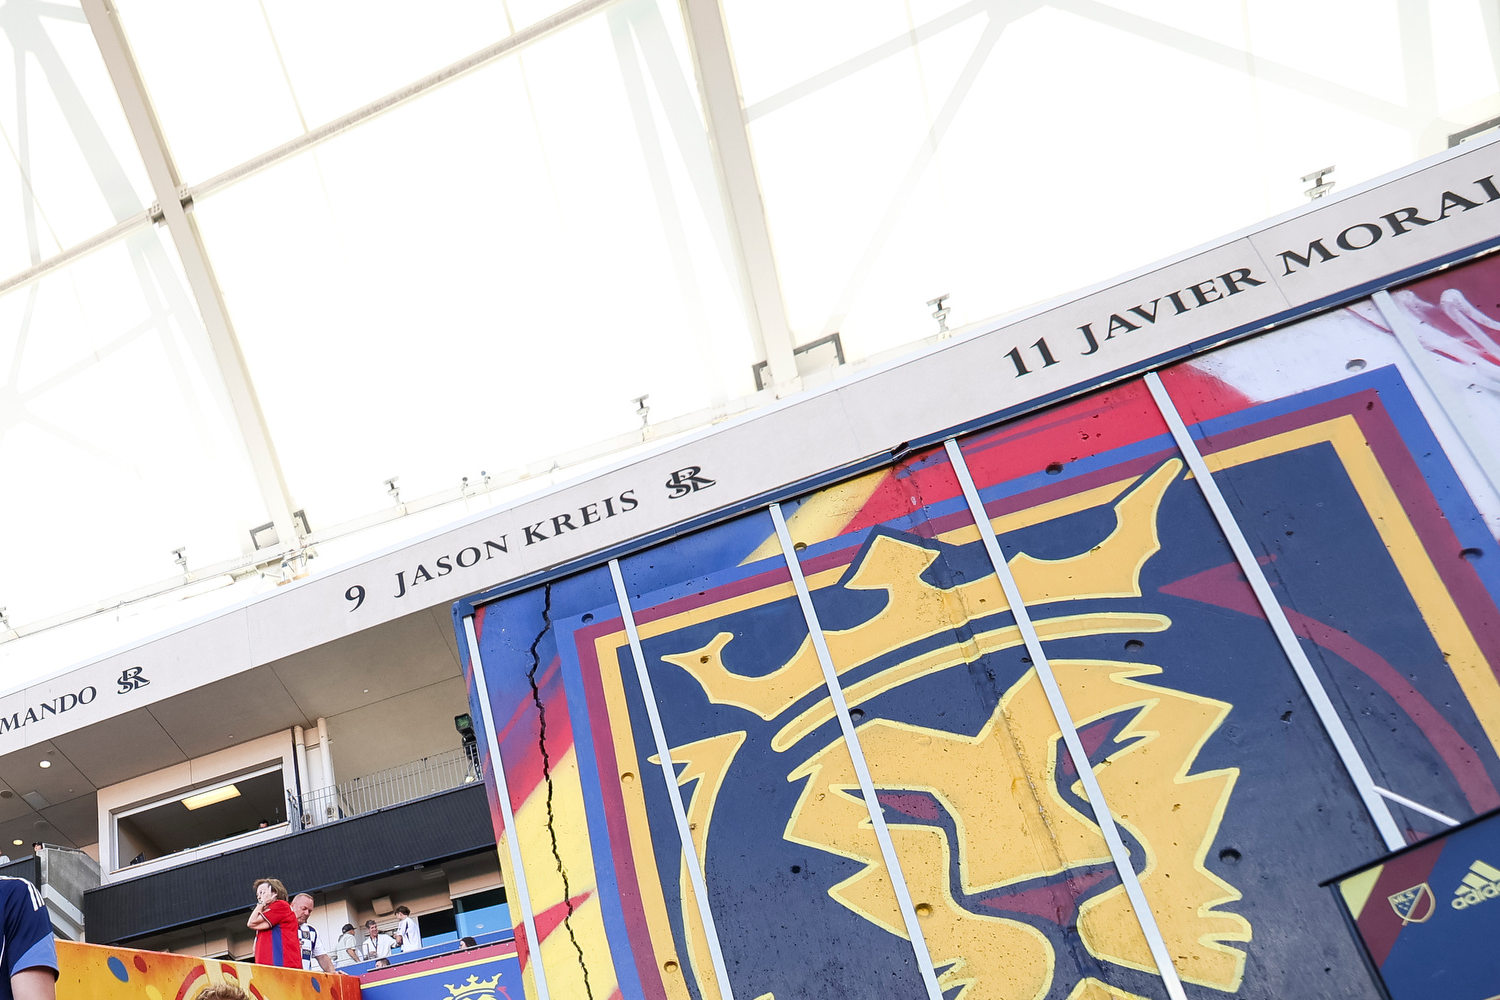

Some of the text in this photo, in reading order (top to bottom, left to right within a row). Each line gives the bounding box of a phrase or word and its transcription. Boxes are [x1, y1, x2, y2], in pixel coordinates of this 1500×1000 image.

[1002, 336, 1061, 379] 11
[1076, 266, 1266, 356] JAVIER
[344, 584, 366, 613] 9
[393, 533, 508, 599] JASON
[521, 488, 639, 547] KREIS
